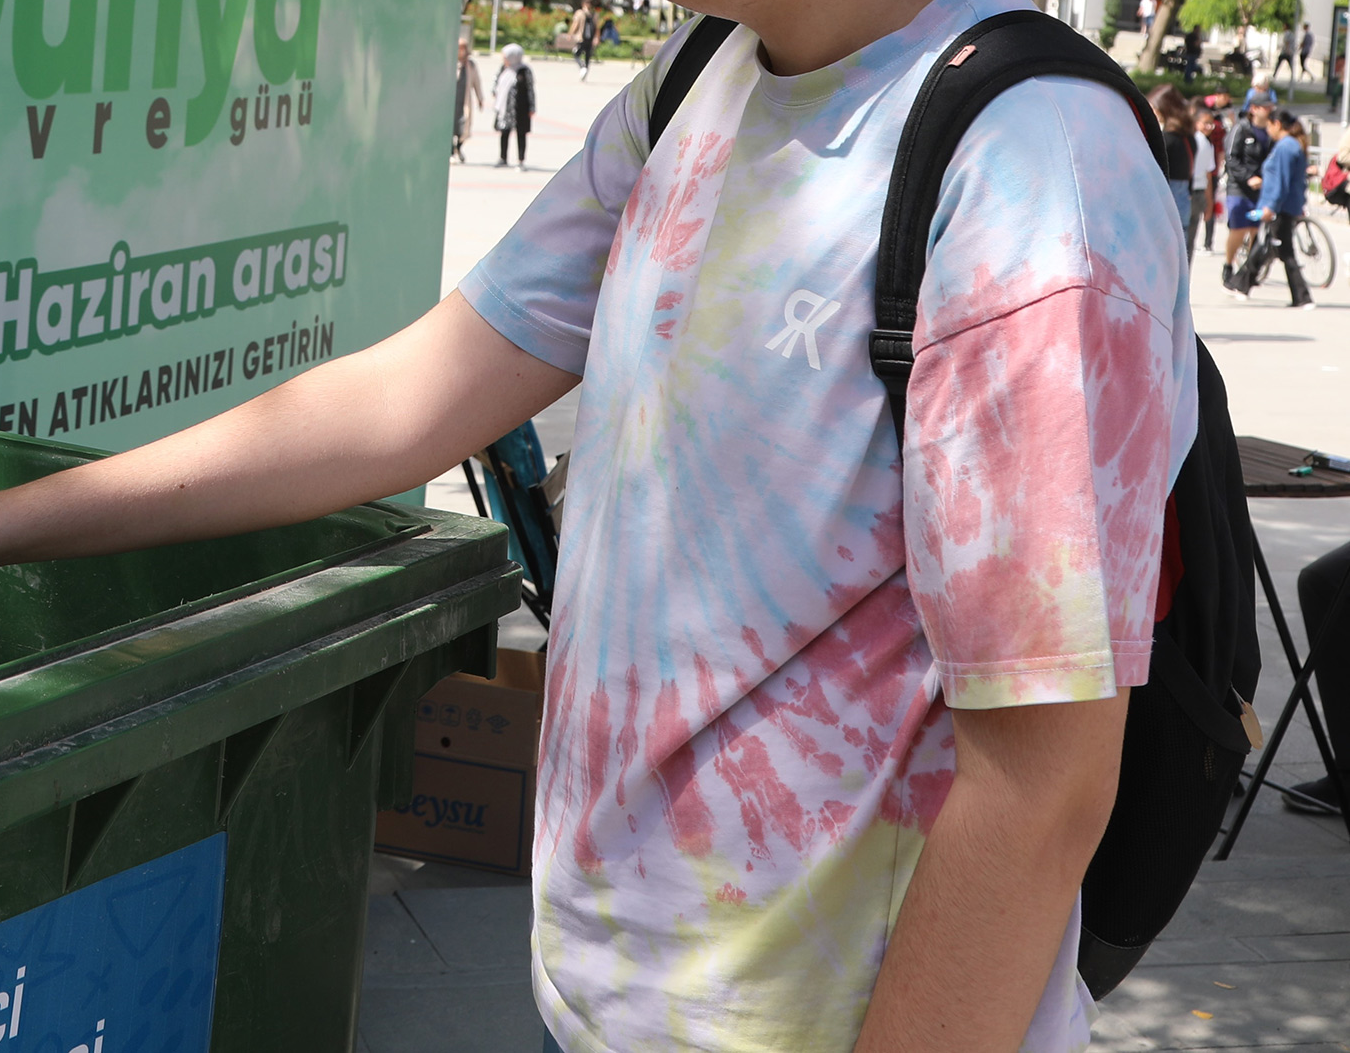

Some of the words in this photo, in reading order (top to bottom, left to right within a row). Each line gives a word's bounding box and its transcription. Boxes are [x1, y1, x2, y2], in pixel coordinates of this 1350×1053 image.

[230, 81, 314, 147] günü
[233, 232, 347, 302] arası
[48, 348, 234, 438] ATIKLARINIZI
[243, 315, 335, 380] GETİRİN
[394, 793, 489, 828] eysu
